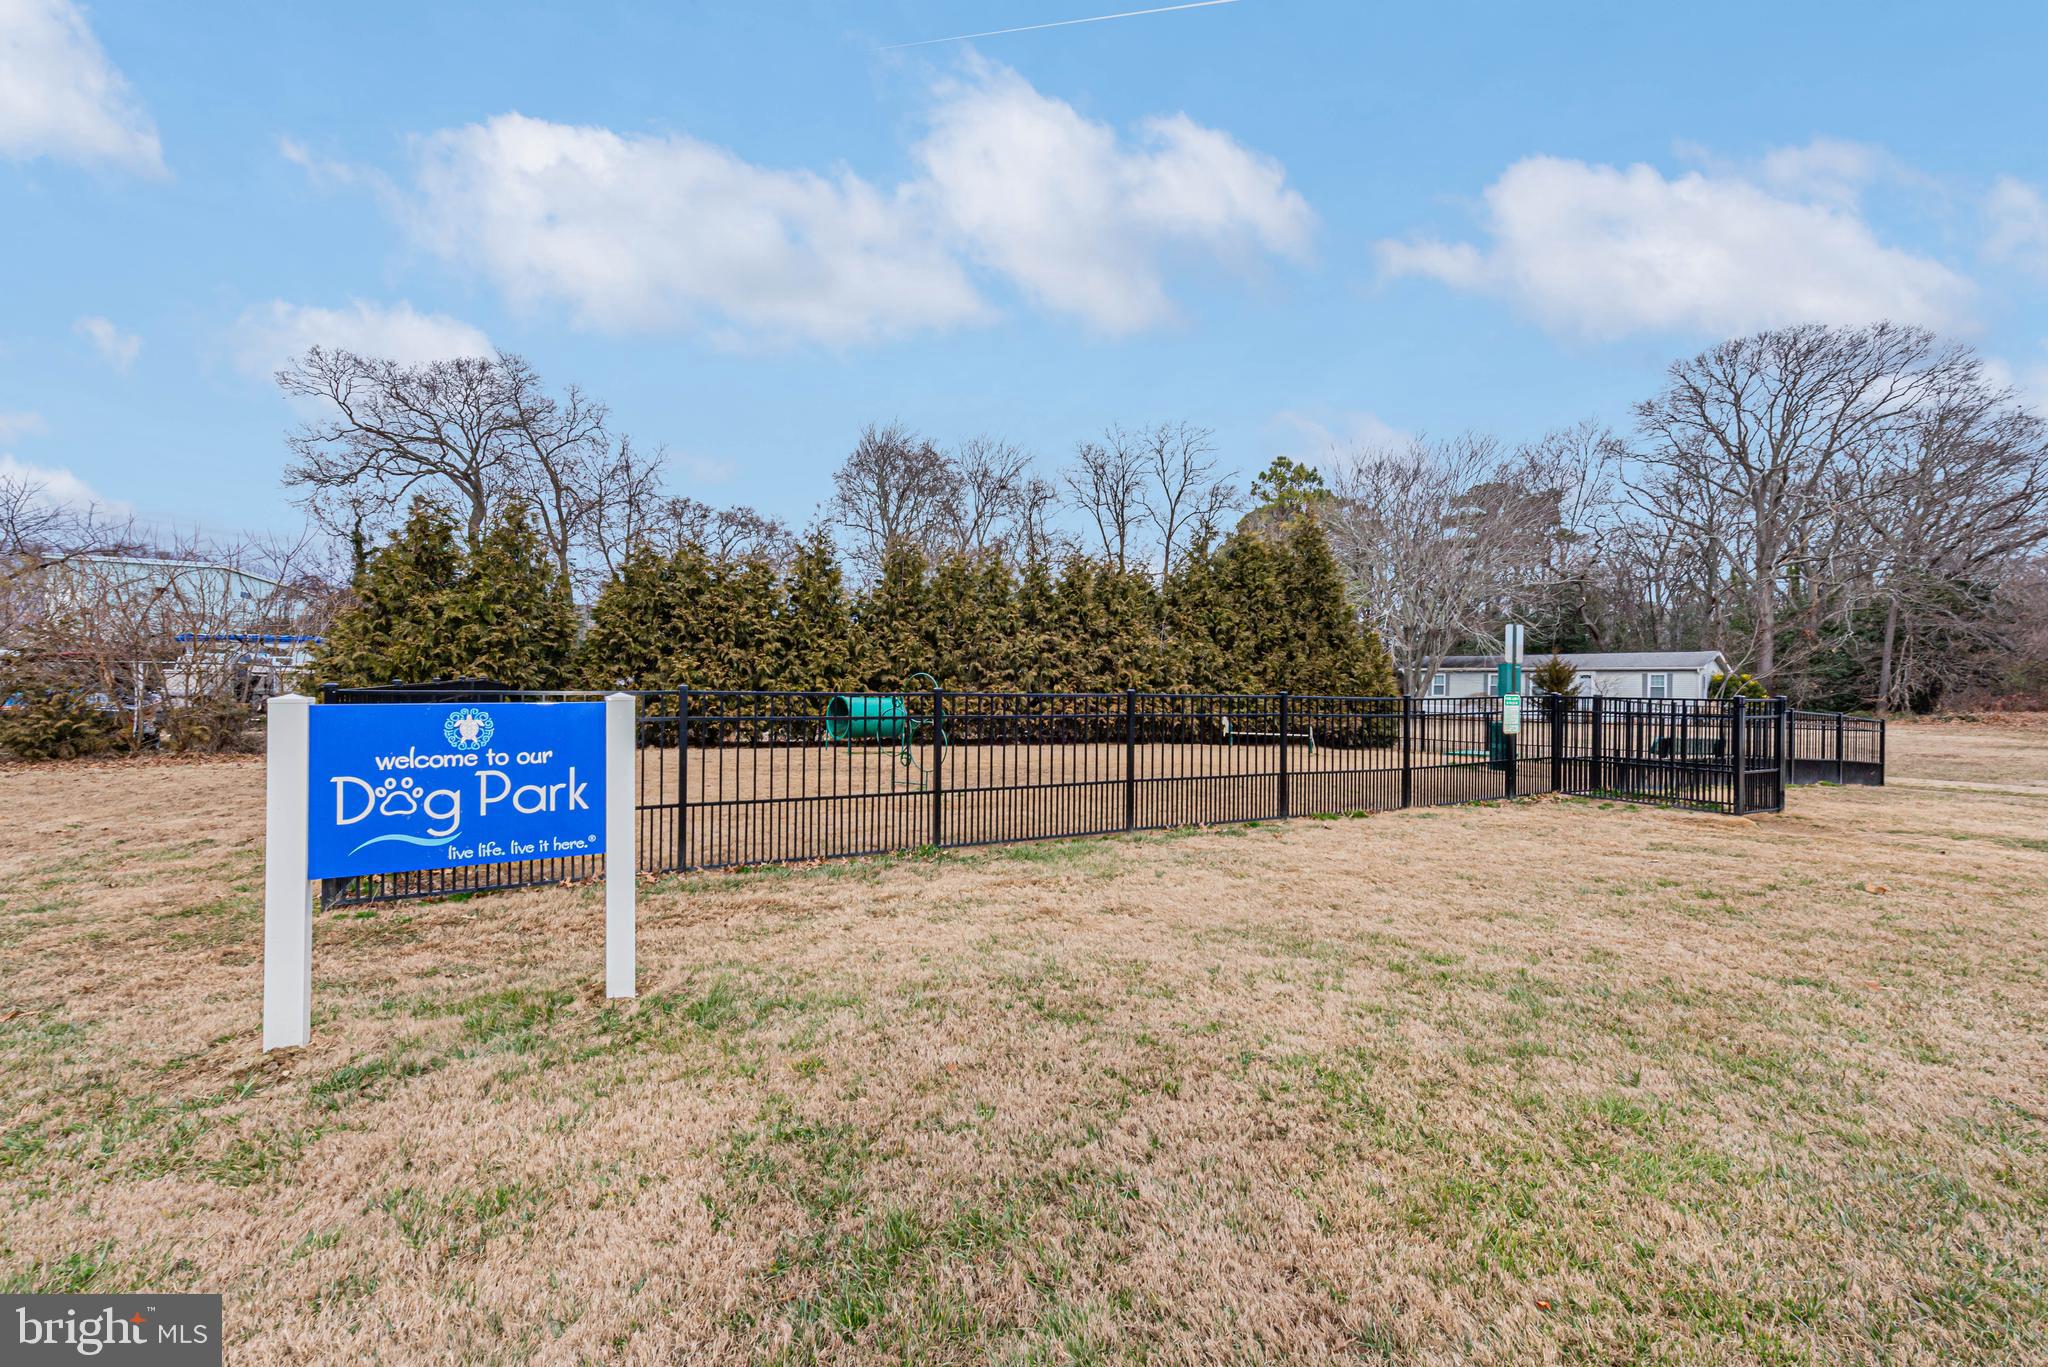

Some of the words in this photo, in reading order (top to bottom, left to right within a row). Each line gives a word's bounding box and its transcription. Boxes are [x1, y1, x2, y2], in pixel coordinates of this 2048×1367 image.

[375, 746, 479, 771] welcome
[486, 748, 510, 766] to
[516, 751, 553, 765] our
[474, 766, 590, 817] Park
[448, 845, 474, 860] live
[478, 842, 506, 857] life.
[510, 840, 535, 855] live
[539, 839, 549, 852] it
